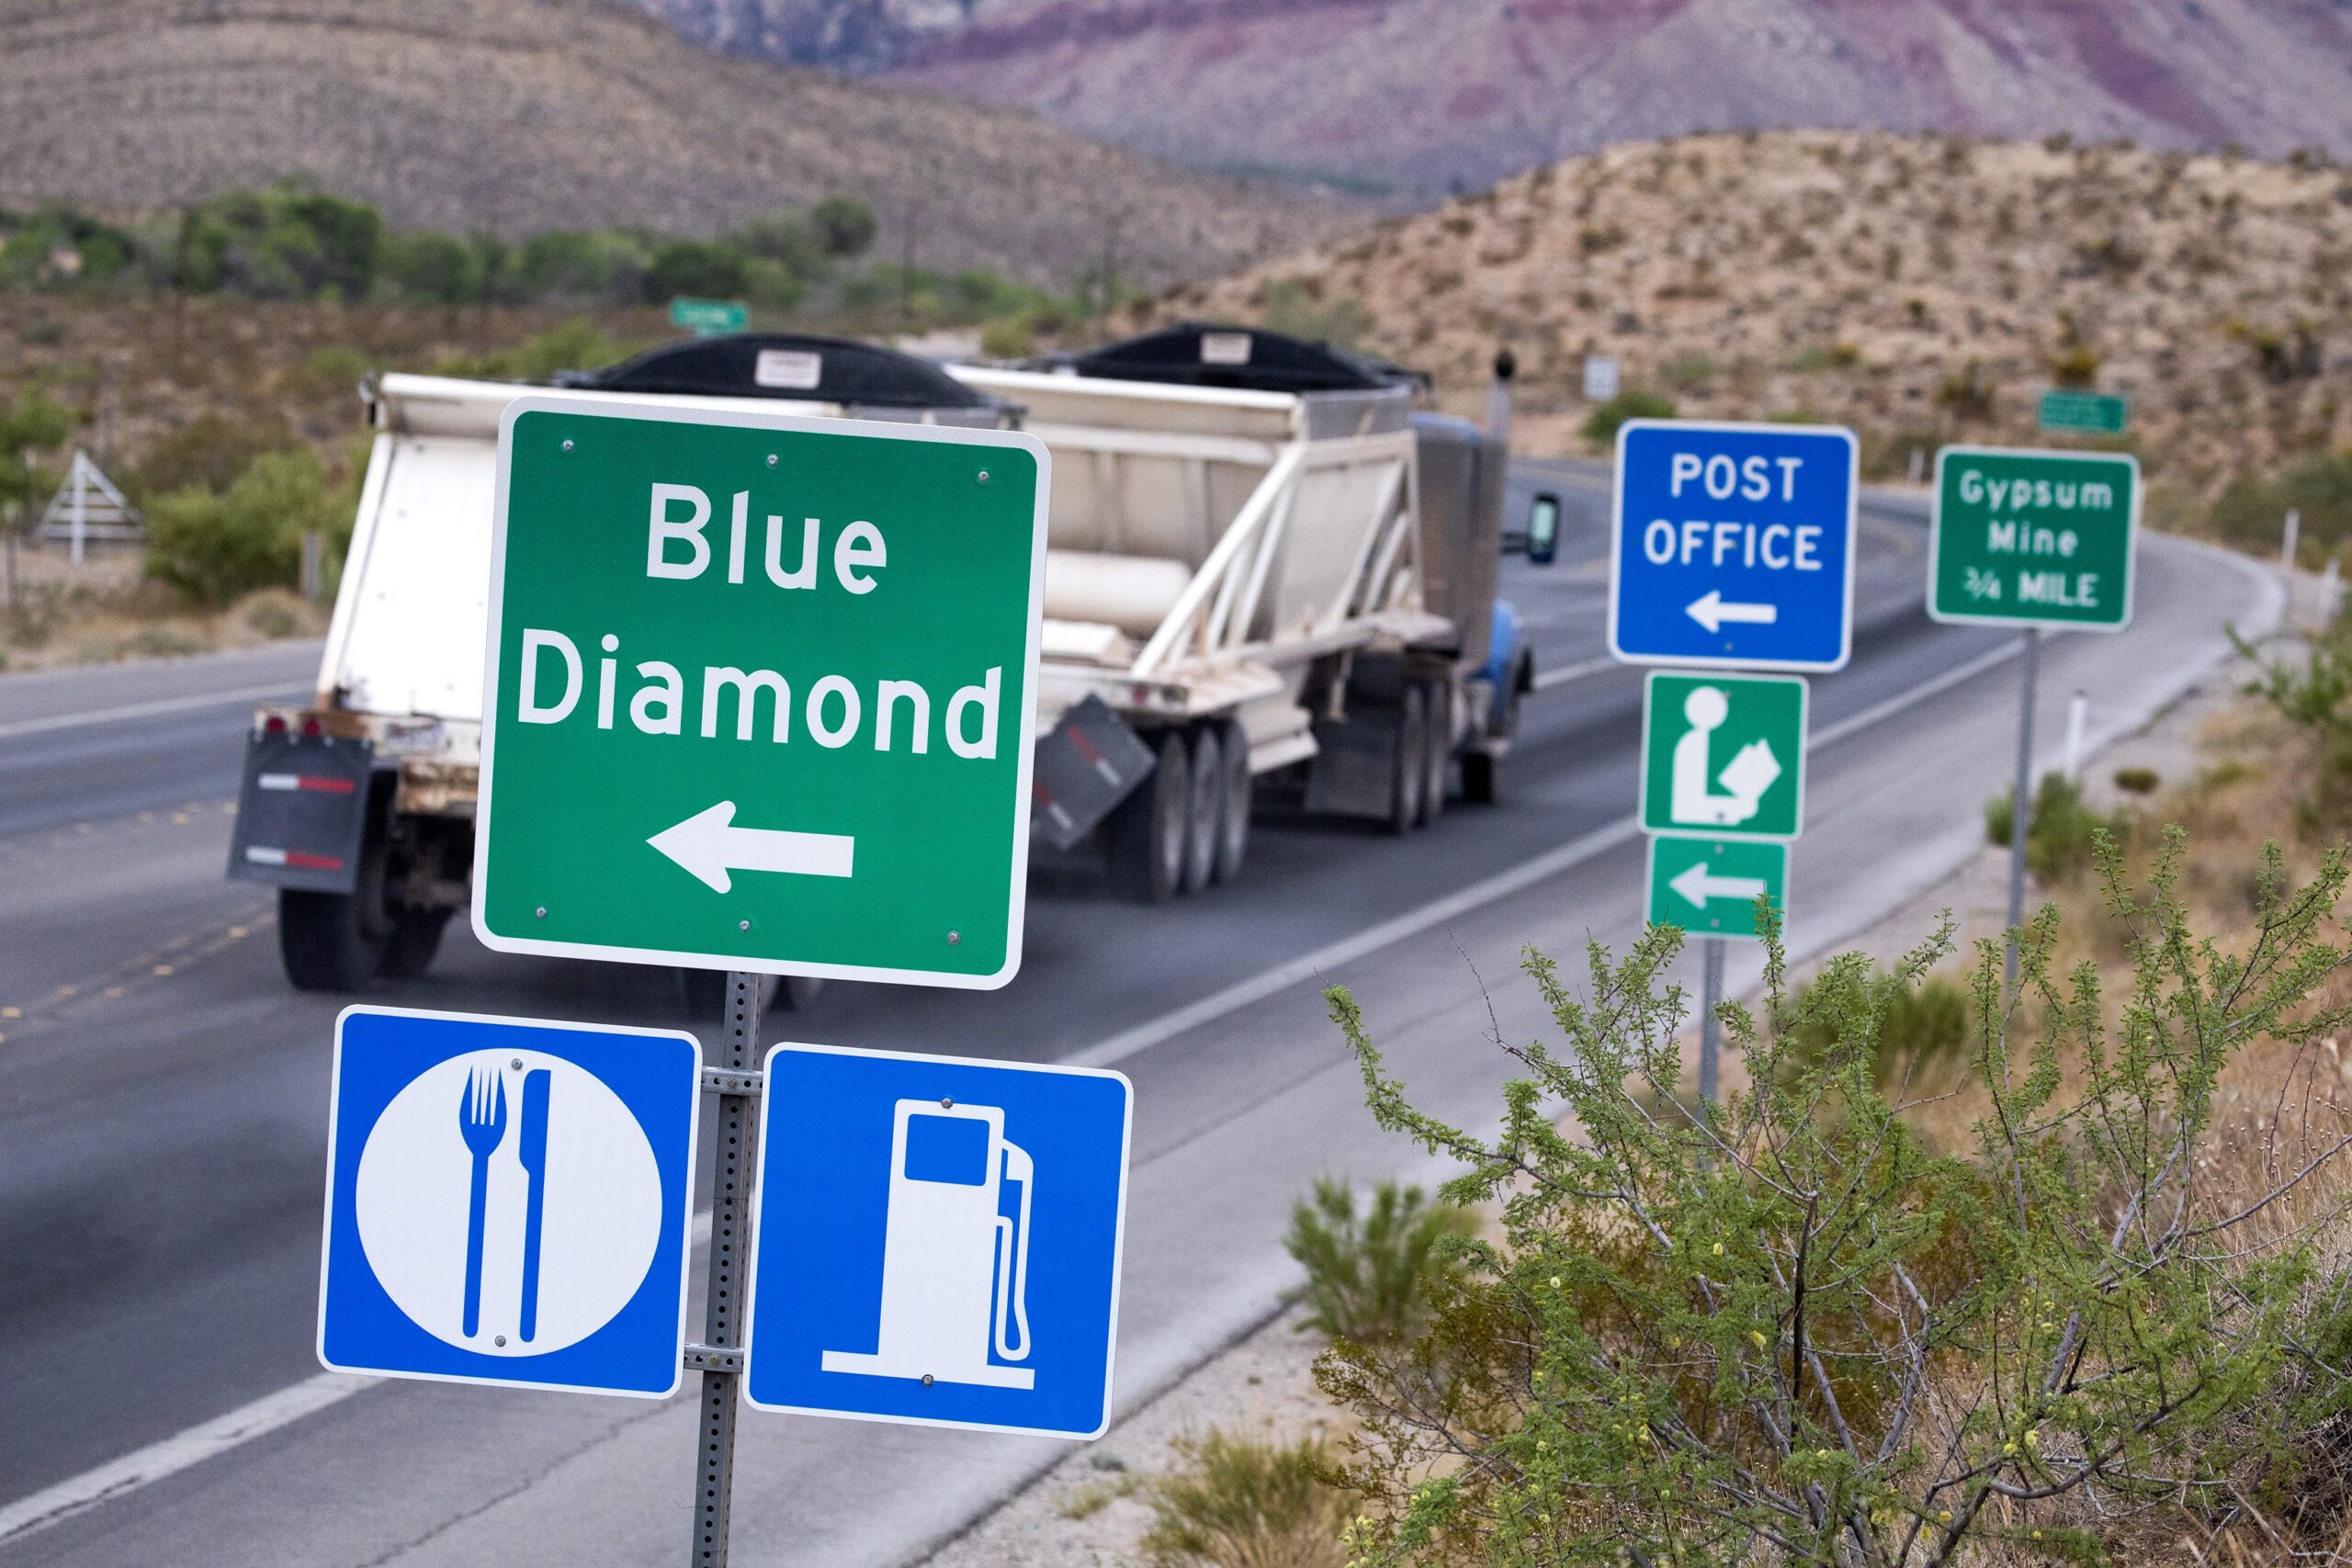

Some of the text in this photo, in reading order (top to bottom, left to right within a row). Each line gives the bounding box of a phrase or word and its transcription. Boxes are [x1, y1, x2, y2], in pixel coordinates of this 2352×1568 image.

[1671, 453, 1804, 501] POST
[1960, 470, 2113, 511] Gypsum
[647, 483, 888, 594] Blue
[1644, 519, 1823, 570] OFFICE
[1988, 521, 2078, 556] Mine
[2018, 572, 2098, 607] MILE
[517, 628, 1002, 760] Diamond
